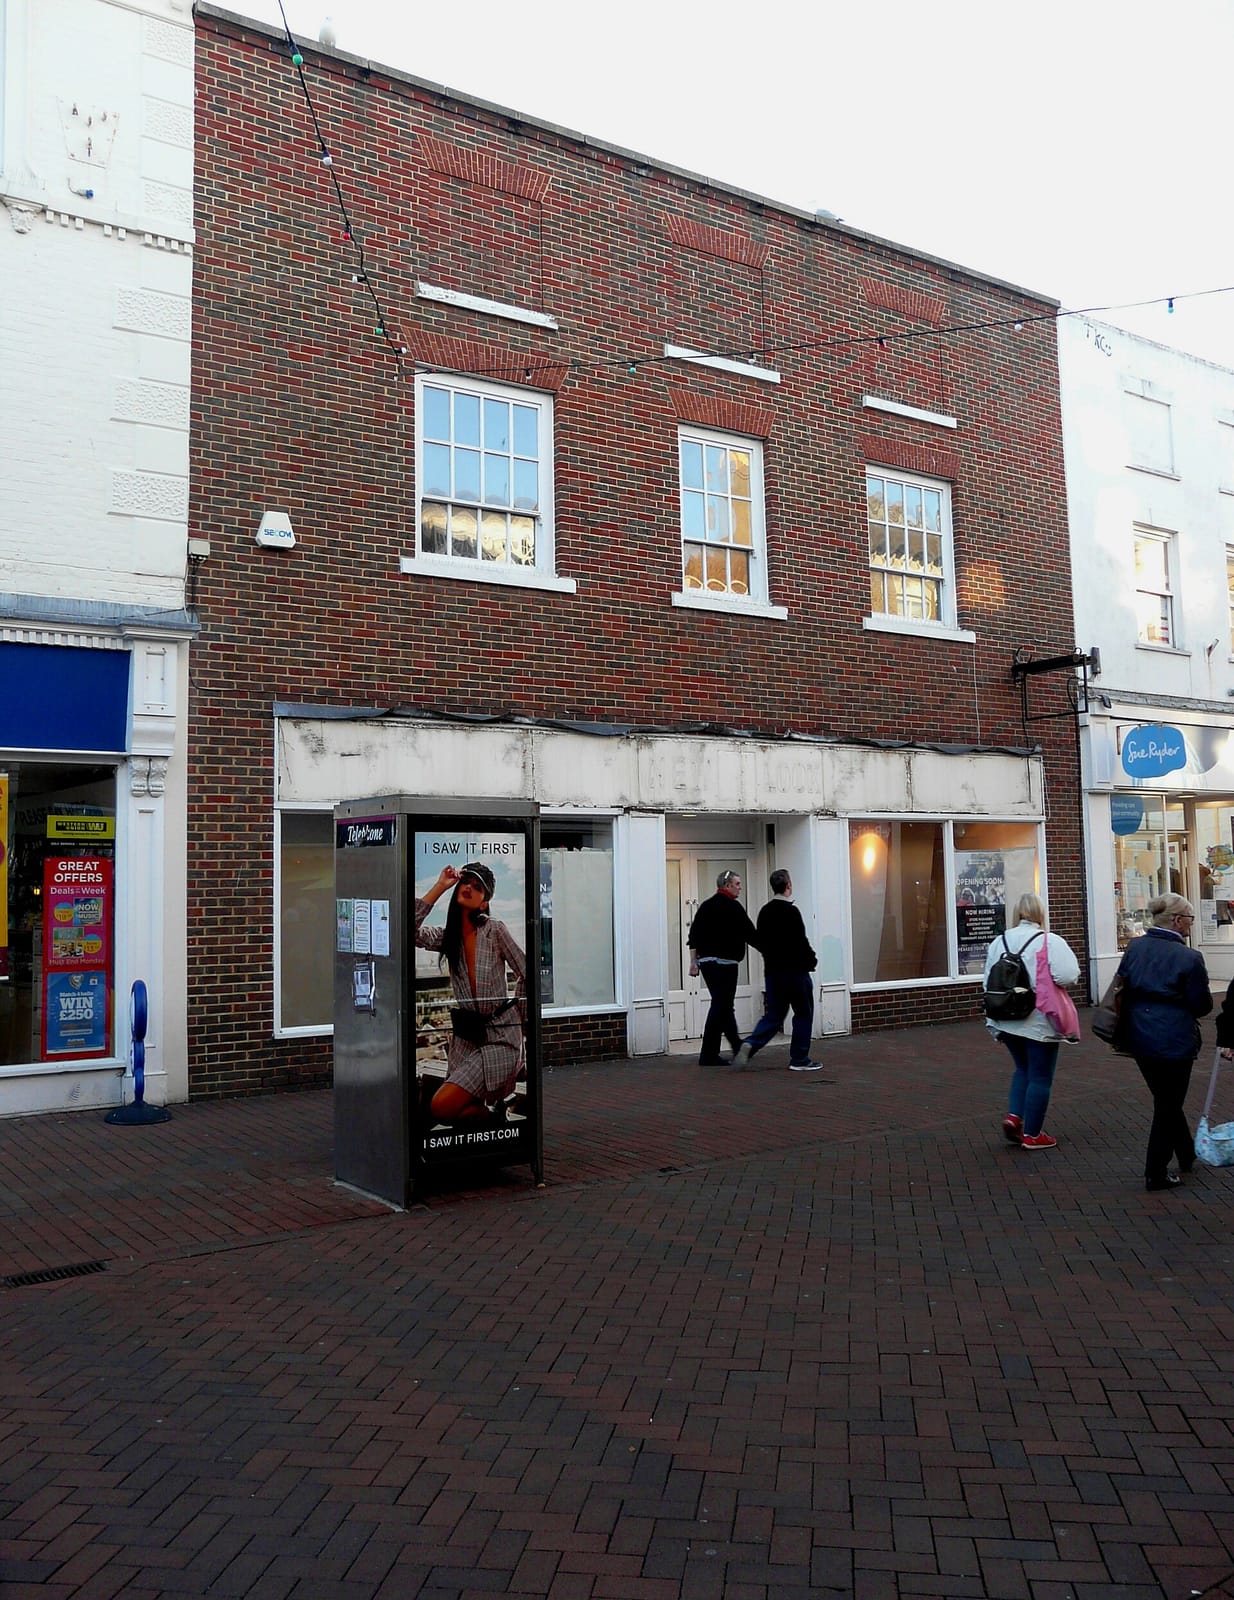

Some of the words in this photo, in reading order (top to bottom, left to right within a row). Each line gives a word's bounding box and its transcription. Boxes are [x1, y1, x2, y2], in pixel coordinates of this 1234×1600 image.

[1128, 740, 1149, 763] Sue
[1149, 741, 1180, 764] Ryder
[424, 842, 428, 855] I
[432, 842, 460, 855] SAW
[466, 842, 477, 855] IT
[481, 842, 517, 855] FIRST
[58, 861, 100, 871] GREAT
[54, 872, 103, 883] OFFERS
[955, 878, 984, 887] OPENING
[50, 887, 75, 895] Deals
[81, 887, 106, 895] Week
[60, 996, 94, 1010] WIN
[59, 1008, 94, 1021] £250
[423, 1139, 427, 1149] I
[430, 1136, 453, 1149] SAW
[455, 1134, 465, 1145] IT
[467, 1127, 519, 1144] FIRST.COM
